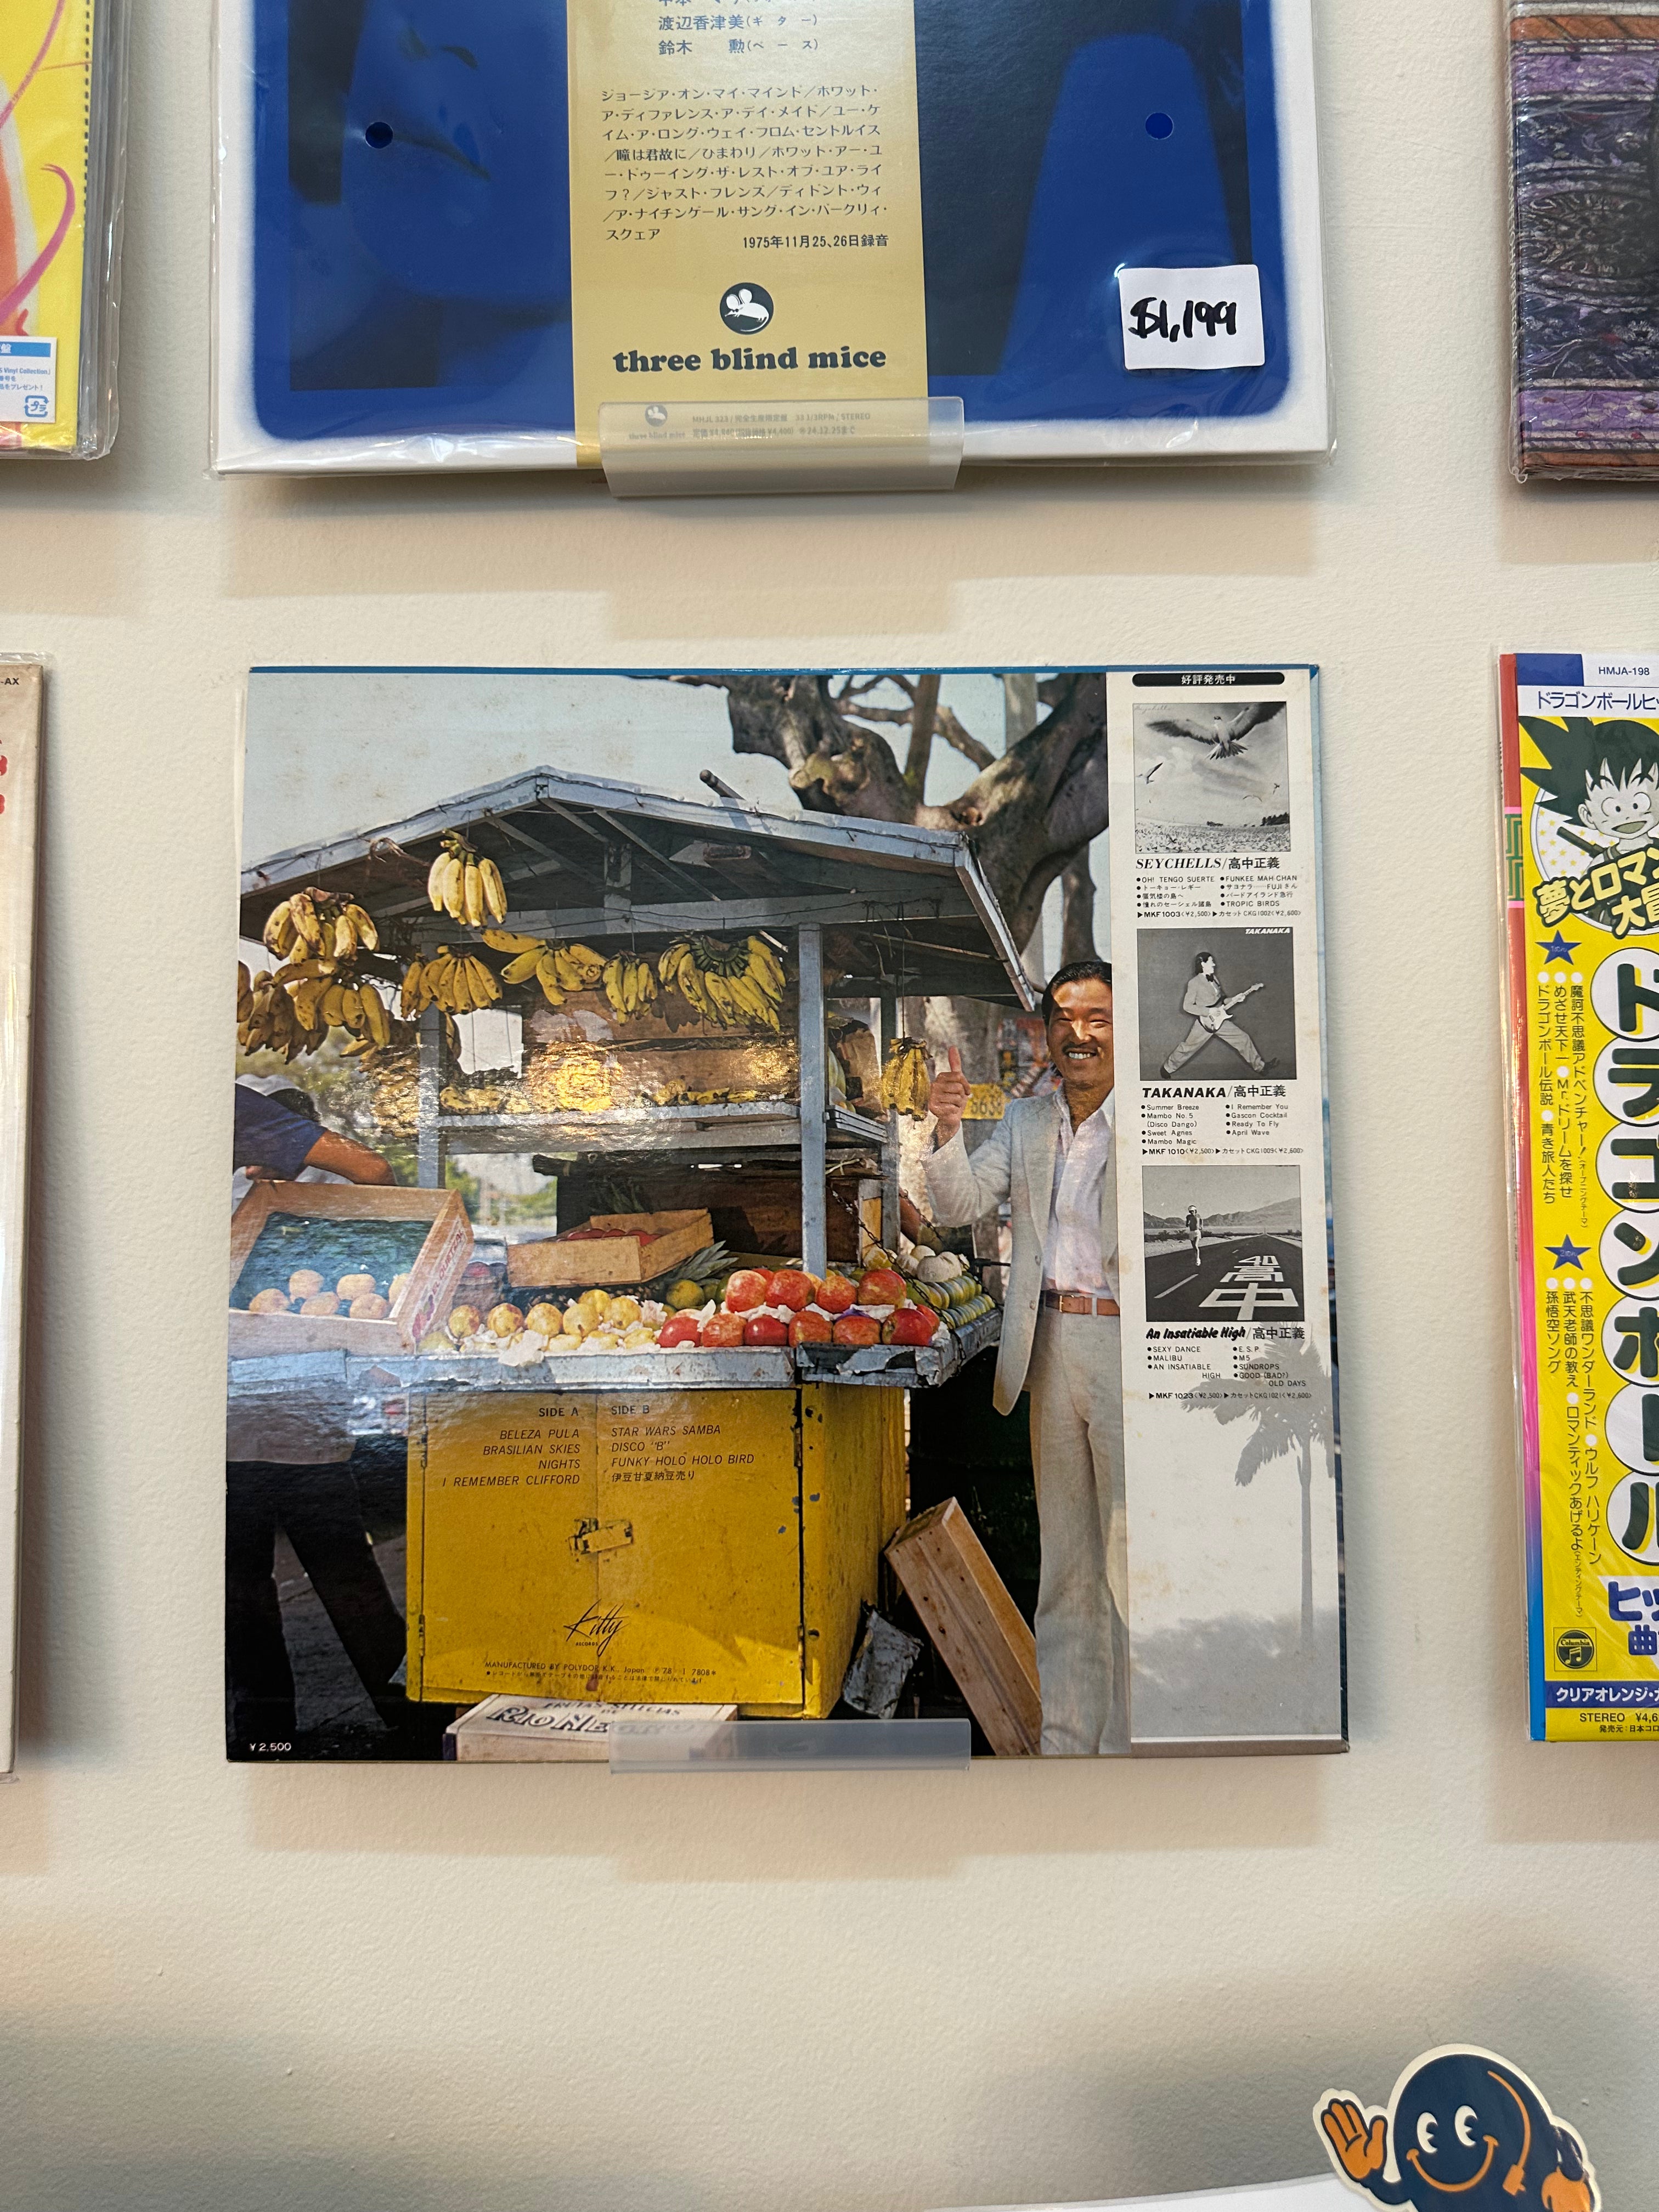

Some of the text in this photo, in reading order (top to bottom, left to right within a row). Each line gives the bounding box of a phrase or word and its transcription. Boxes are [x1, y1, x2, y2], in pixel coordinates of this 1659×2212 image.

[1128, 297, 1237, 342] $1,199
[613, 346, 886, 373] three blind mice
[31, 401, 46, 411] プラ
[1181, 674, 1235, 685] 好評発売中
[1538, 691, 1659, 710] ドラゴンボールヒ
[1538, 985, 1556, 1204] ドラゴンボール伝説 青き旅人たち
[1146, 1327, 1218, 1339] An Insatiable
[1545, 1291, 1561, 1374] 孫悟空ソング
[1562, 1291, 1578, 1387] 武天老師の教え
[539, 1407, 579, 1417] SIDE A
[611, 1404, 650, 1415] SIDE B
[500, 1429, 579, 1440] BELEZA PULA
[611, 1425, 720, 1437] STAR WARS SAMBA
[483, 1444, 581, 1455] BRASILIAN SKIES
[611, 1442, 645, 1452] DISCO
[538, 1459, 581, 1469] NIGHTS
[611, 1454, 754, 1467] FUNKY HOLO HOLO BIRD
[1585, 1447, 1599, 1489] ウルフ
[453, 1475, 520, 1487] REMEMBER
[526, 1474, 580, 1485] CLIFFORD
[563, 1598, 631, 1657] Kitty
[485, 1661, 546, 1669] MANUFACTURED
[1579, 1713, 1659, 1724] STEREO ¥4,6
